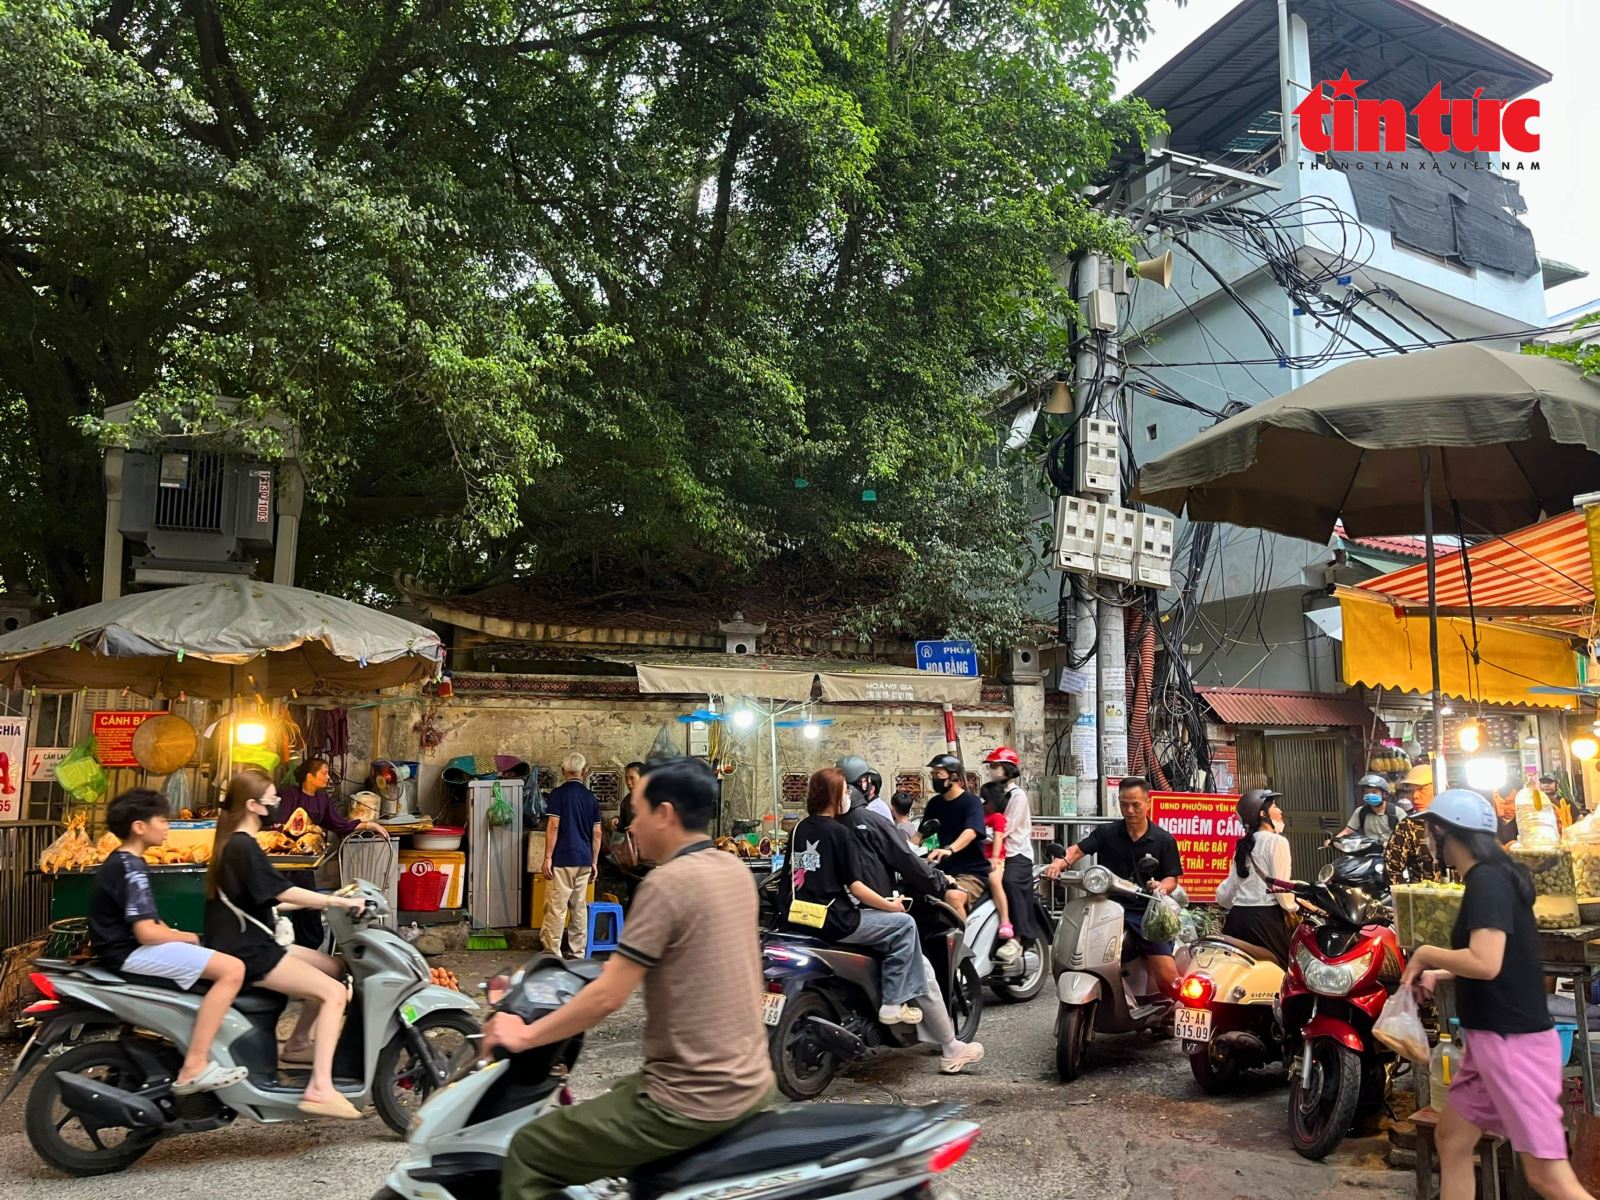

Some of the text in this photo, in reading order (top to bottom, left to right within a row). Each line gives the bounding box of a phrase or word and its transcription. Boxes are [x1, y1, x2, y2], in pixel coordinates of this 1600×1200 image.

[1159, 802, 1180, 810] UBND
[1158, 814, 1246, 837] NGHIÊM CẤM
[1193, 840, 1210, 852] RÁC
[1212, 840, 1228, 855] BẬY
[1187, 855, 1205, 869] THẢI
[1211, 856, 1228, 870] PHẾ
[1179, 1010, 1206, 1026] 29-AA
[1176, 1024, 1208, 1040] 615.09
